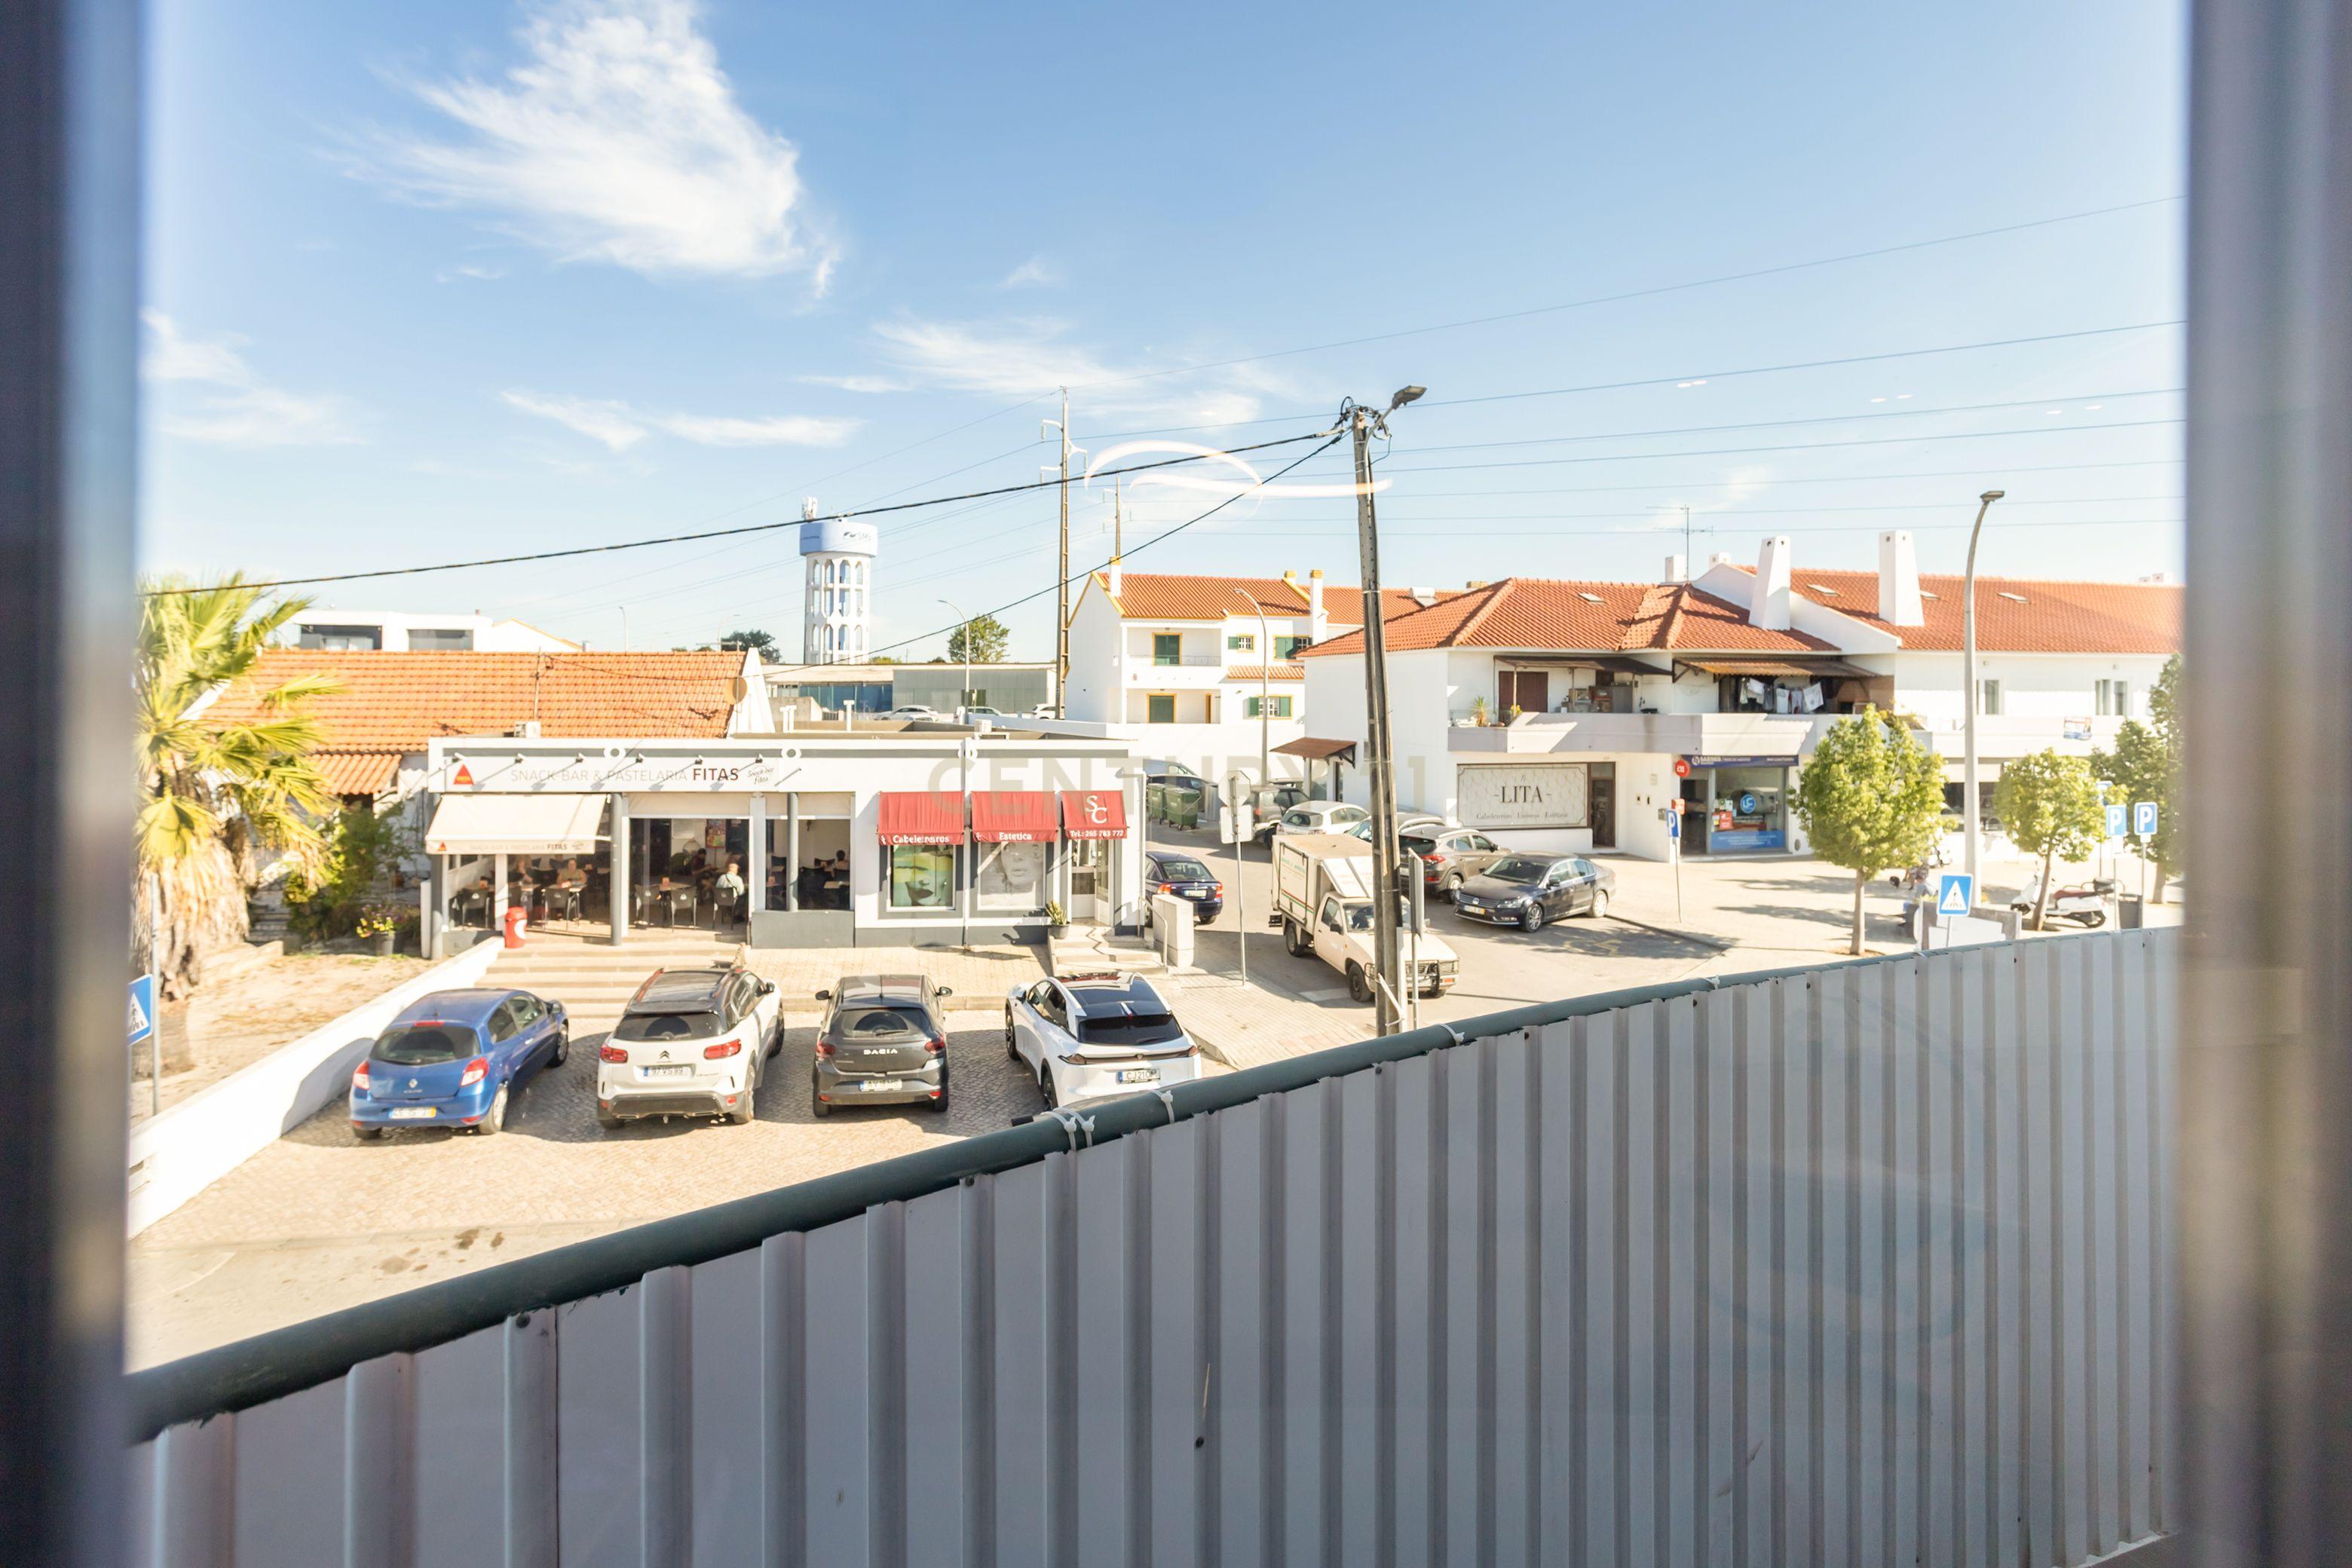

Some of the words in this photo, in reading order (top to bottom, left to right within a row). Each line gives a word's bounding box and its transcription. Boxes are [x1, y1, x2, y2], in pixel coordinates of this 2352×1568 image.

[510, 770, 588, 782] SNACK-BAR
[608, 770, 687, 782] PASTELARIA
[693, 768, 739, 781] FITAS
[1501, 786, 1542, 804] LITA
[1668, 811, 1676, 836] P
[2109, 808, 2123, 835] P
[2139, 806, 2153, 831] P
